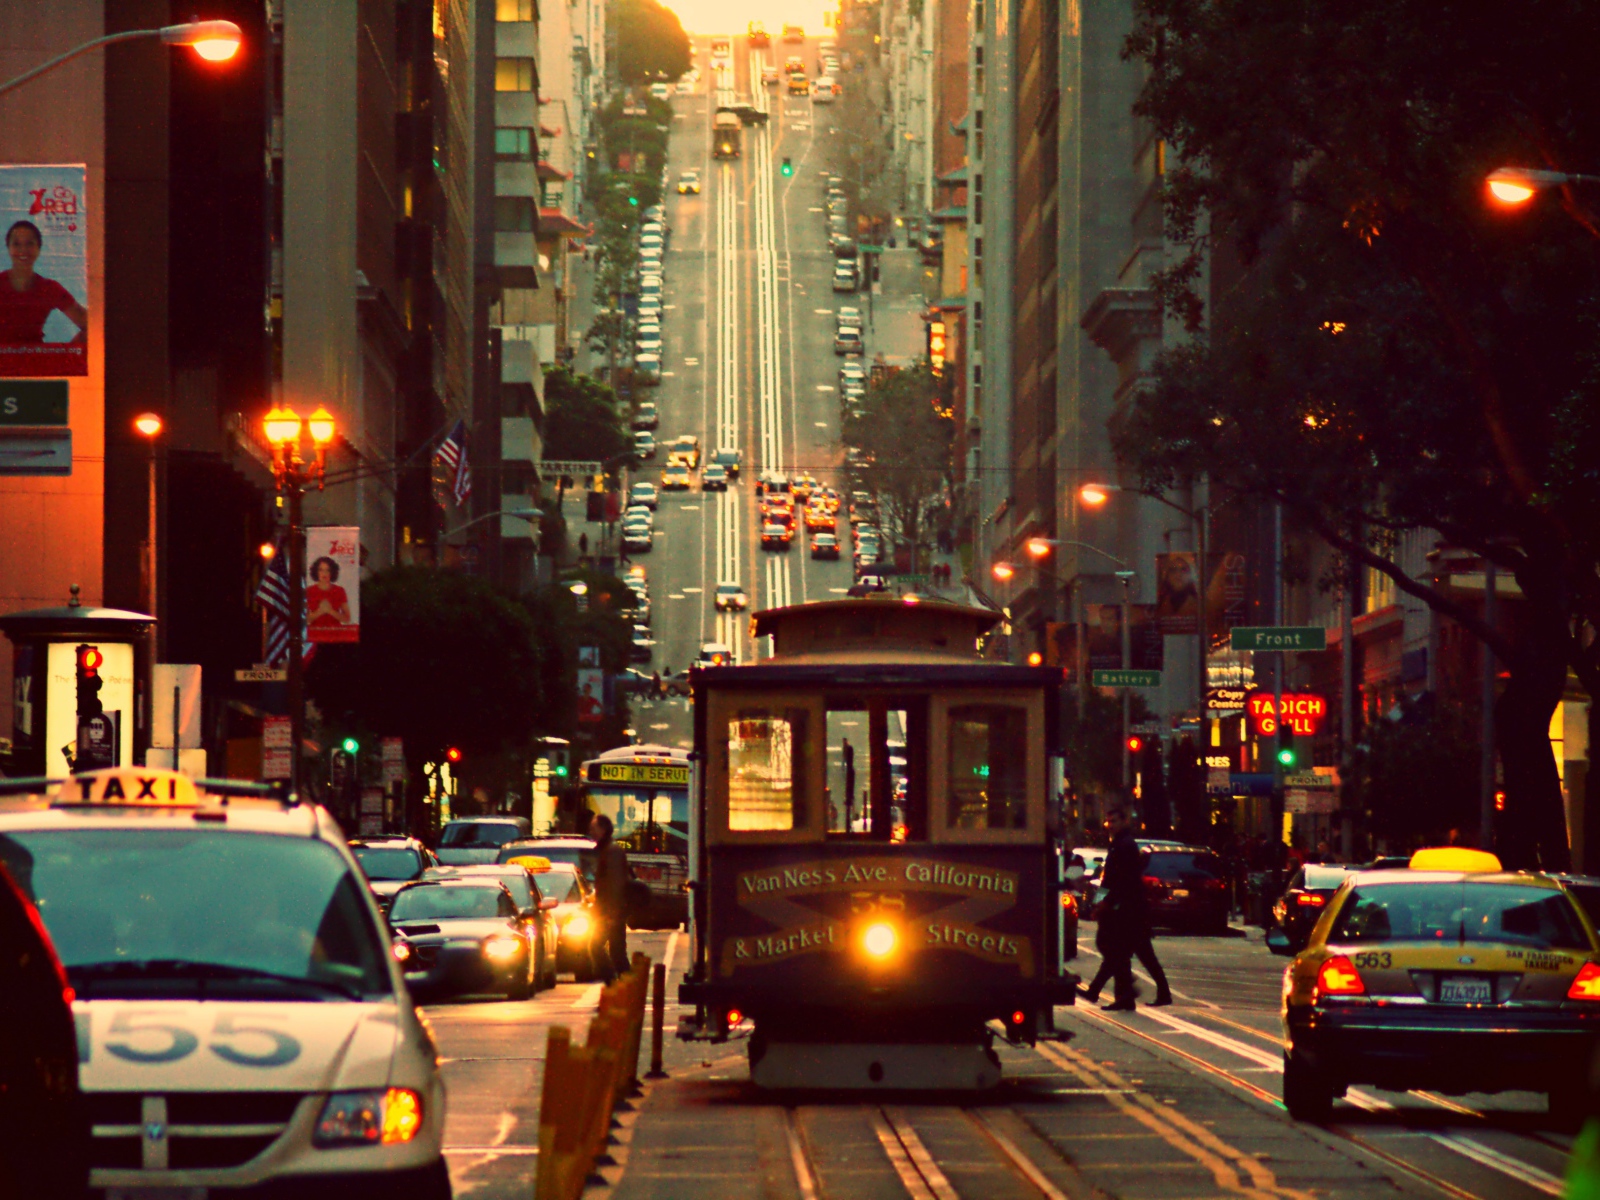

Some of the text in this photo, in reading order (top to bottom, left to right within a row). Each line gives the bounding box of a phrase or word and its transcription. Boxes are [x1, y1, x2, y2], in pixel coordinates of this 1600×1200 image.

[45, 195, 76, 216] Red
[1256, 633, 1300, 645] Front
[243, 671, 278, 679] FRONT
[1102, 674, 1152, 685] Battery
[1217, 689, 1246, 700] Copy
[1208, 699, 1246, 708] Center
[1261, 718, 1312, 732] GLL
[603, 766, 626, 778] NOT
[632, 768, 645, 779] IN
[76, 777, 177, 800] TAXI
[743, 873, 781, 893] Van
[784, 867, 836, 886] Ness
[905, 863, 1014, 894] California
[735, 924, 1019, 958] & Market Streets
[1355, 952, 1392, 969] 563
[1506, 950, 1524, 958] SAN
